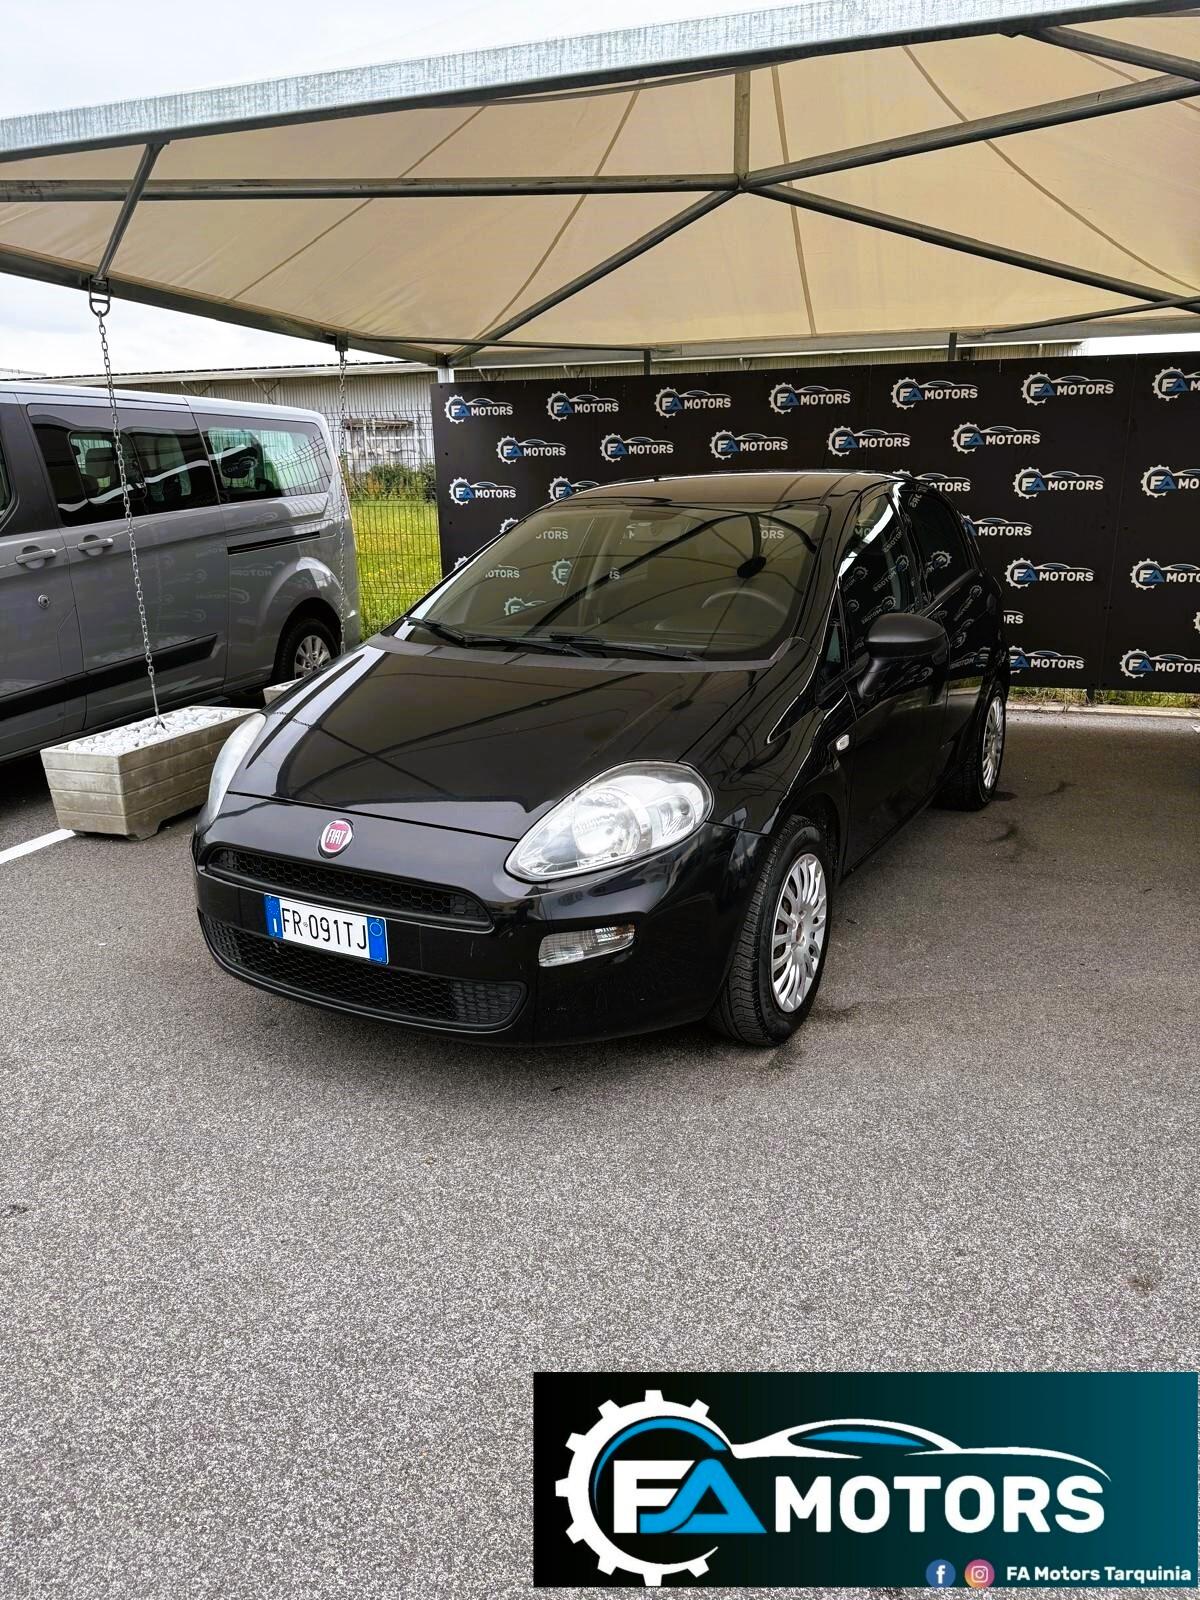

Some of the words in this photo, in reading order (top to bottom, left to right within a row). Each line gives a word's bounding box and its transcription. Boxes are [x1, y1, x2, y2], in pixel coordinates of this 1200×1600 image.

[1030, 383, 1055, 397] FA
[1056, 382, 1114, 395] MOTORS
[1161, 378, 1189, 392] FA
[777, 392, 800, 406] FA
[801, 393, 851, 405] MOTORS
[900, 386, 923, 400] FA
[924, 387, 978, 399] MOTORS
[553, 403, 573, 414] FA
[574, 402, 619, 413] MOTORS
[662, 397, 683, 410] FA
[684, 397, 731, 409] MOTORS
[451, 405, 470, 416] FA
[471, 405, 514, 416] MOTORS
[717, 439, 740, 452] FA
[740, 440, 788, 451] MOTORS
[835, 436, 858, 449] FA
[859, 437, 910, 448] MOTORS
[960, 432, 985, 446] FA
[985, 433, 1041, 445] MOTORS
[503, 446, 523, 457] FA
[523, 446, 566, 456] MOTORS
[607, 443, 627, 454] FA
[628, 443, 673, 454] MOTORS
[926, 482, 971, 492] OTORS
[1021, 476, 1047, 491] FA
[1048, 479, 1104, 491] MOTORS
[1149, 476, 1177, 490] FA
[455, 488, 475, 499] FA
[475, 488, 517, 498] MOTORS
[978, 526, 1032, 536] MOTORS
[1013, 567, 1038, 581] FA
[1038, 571, 1094, 581] MOTORS
[1138, 569, 1165, 582] FA
[1030, 659, 1085, 669] MOTORS
[1128, 659, 1154, 672] FA
[326, 828, 346, 845] FIAT
